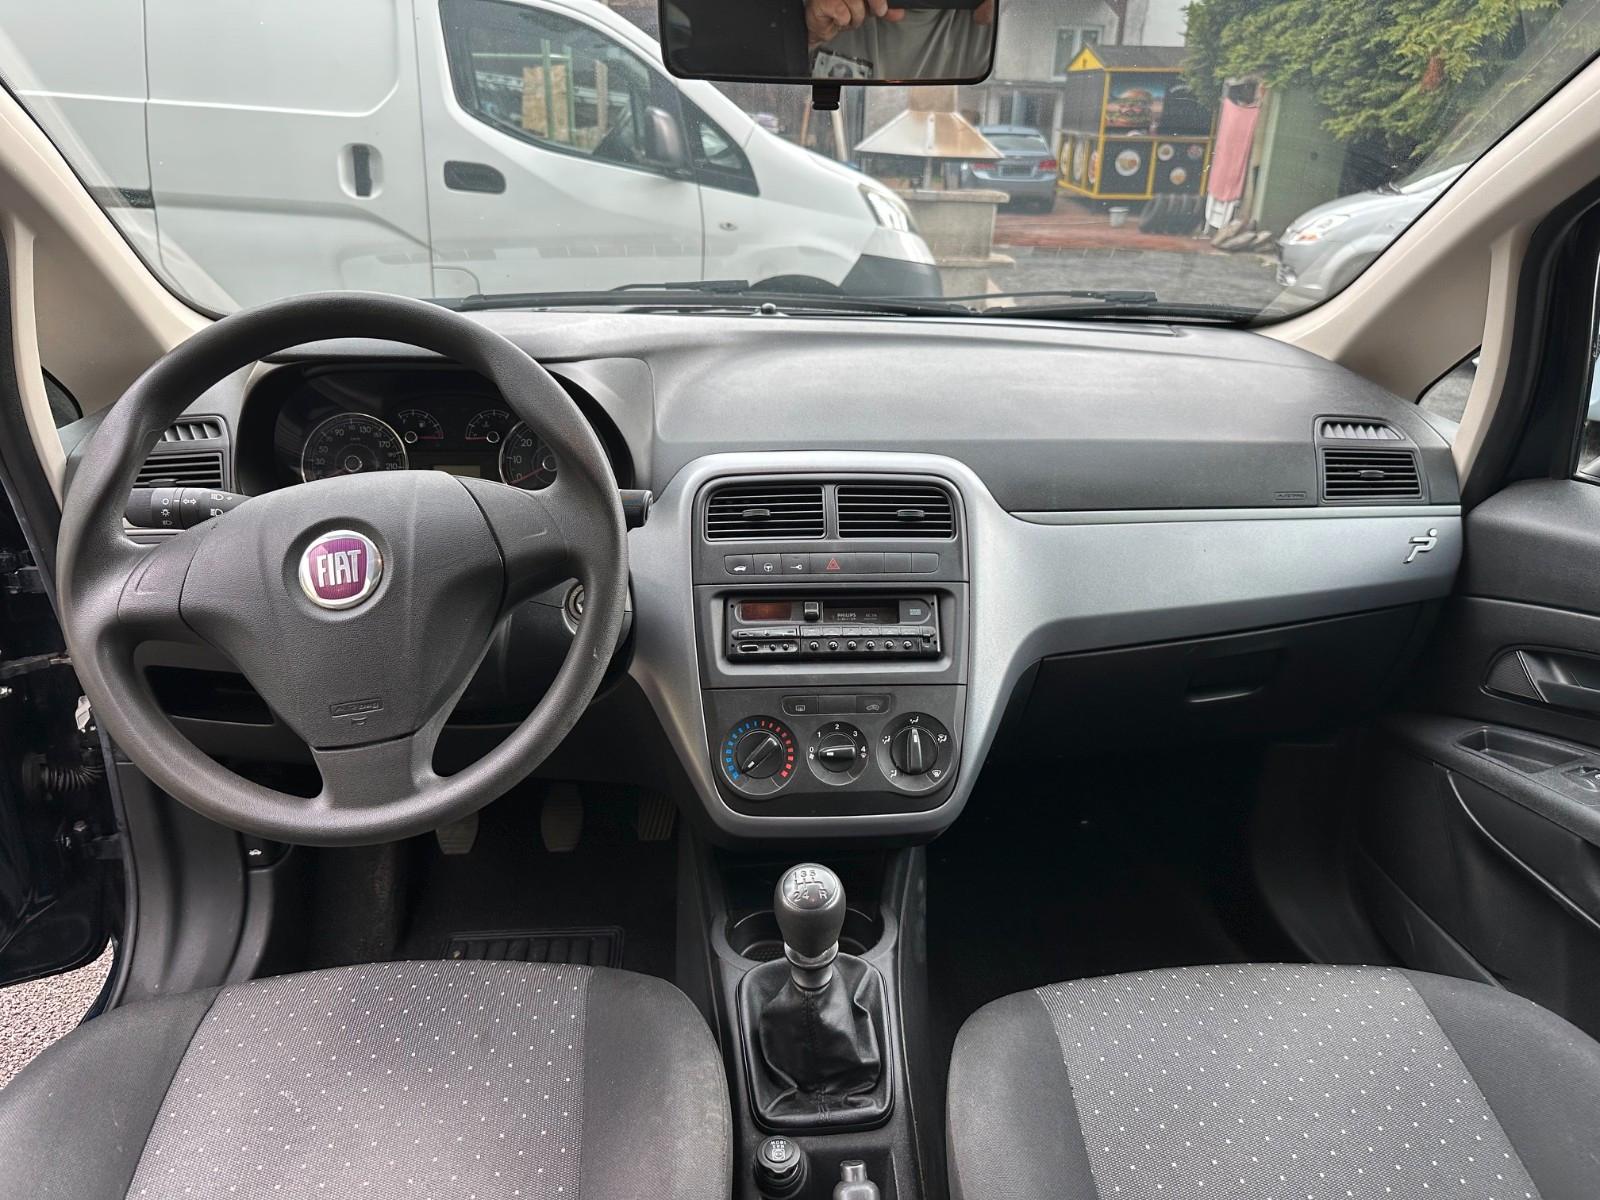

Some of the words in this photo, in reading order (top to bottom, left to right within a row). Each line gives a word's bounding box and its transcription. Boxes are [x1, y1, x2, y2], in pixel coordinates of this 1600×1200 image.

[334, 428, 345, 437] 90
[378, 440, 391, 448] 170
[520, 438, 532, 447] 20
[512, 455, 522, 464] 10
[316, 549, 362, 588] FIAT
[860, 745, 866, 753] 4
[800, 870, 807, 878] 3
[809, 869, 816, 877] 5
[793, 891, 801, 902] 2
[801, 889, 810, 900] 4
[818, 888, 828, 900] R
